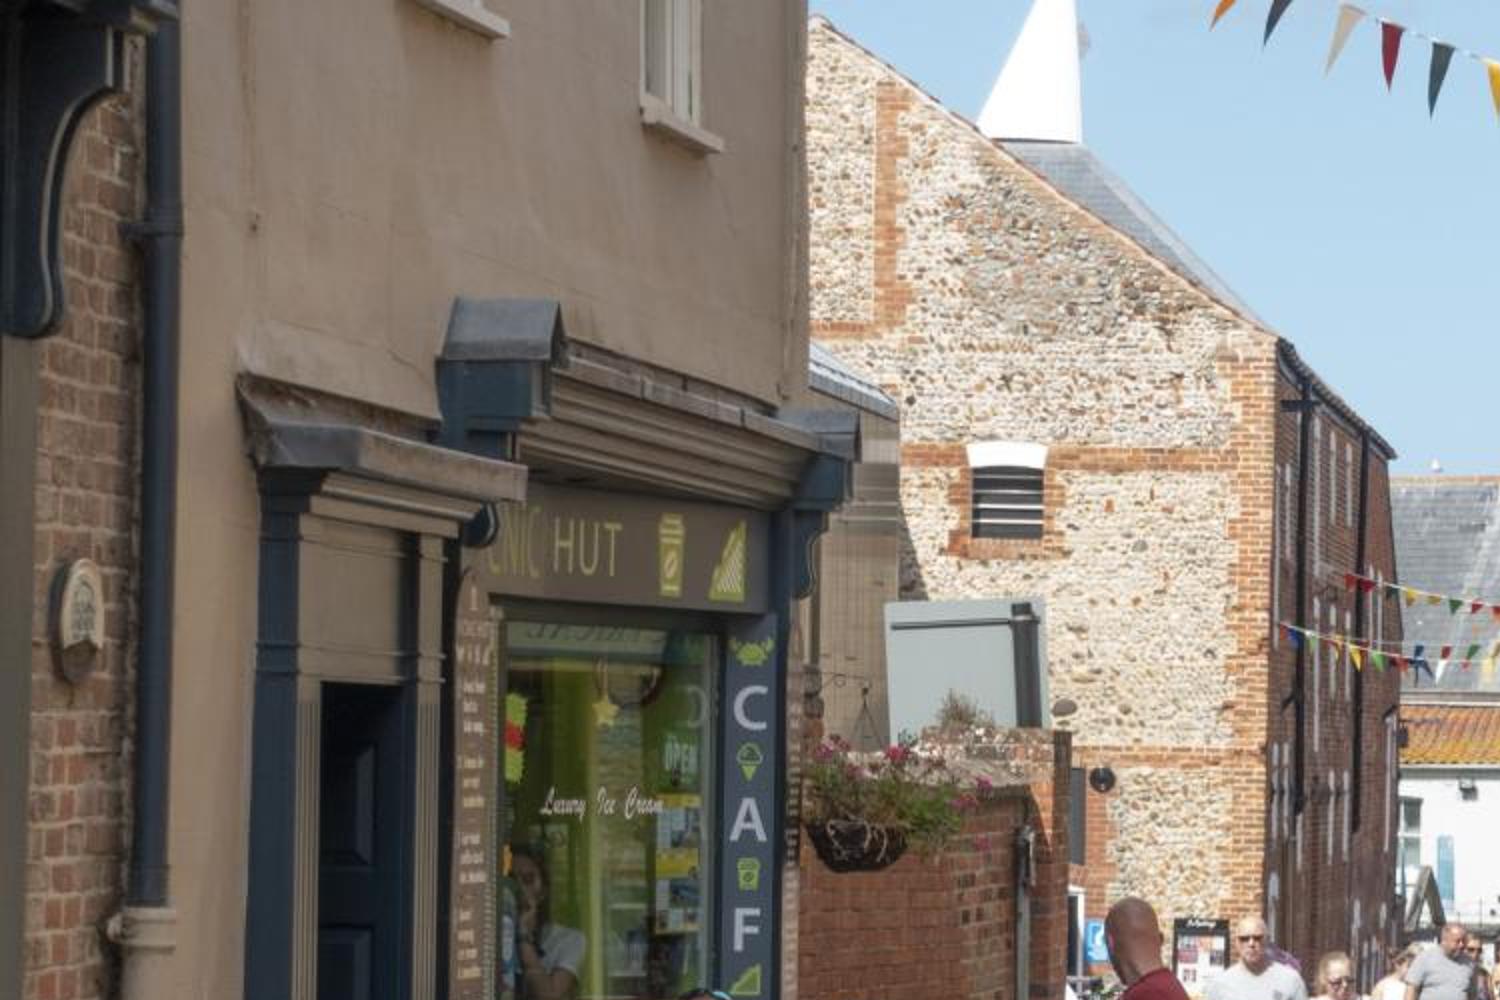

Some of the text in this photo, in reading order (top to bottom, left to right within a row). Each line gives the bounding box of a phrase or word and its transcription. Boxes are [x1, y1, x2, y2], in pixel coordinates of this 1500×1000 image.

[553, 516, 623, 577] HUT
[539, 786, 587, 824] Luxury
[596, 786, 617, 816] Ice
